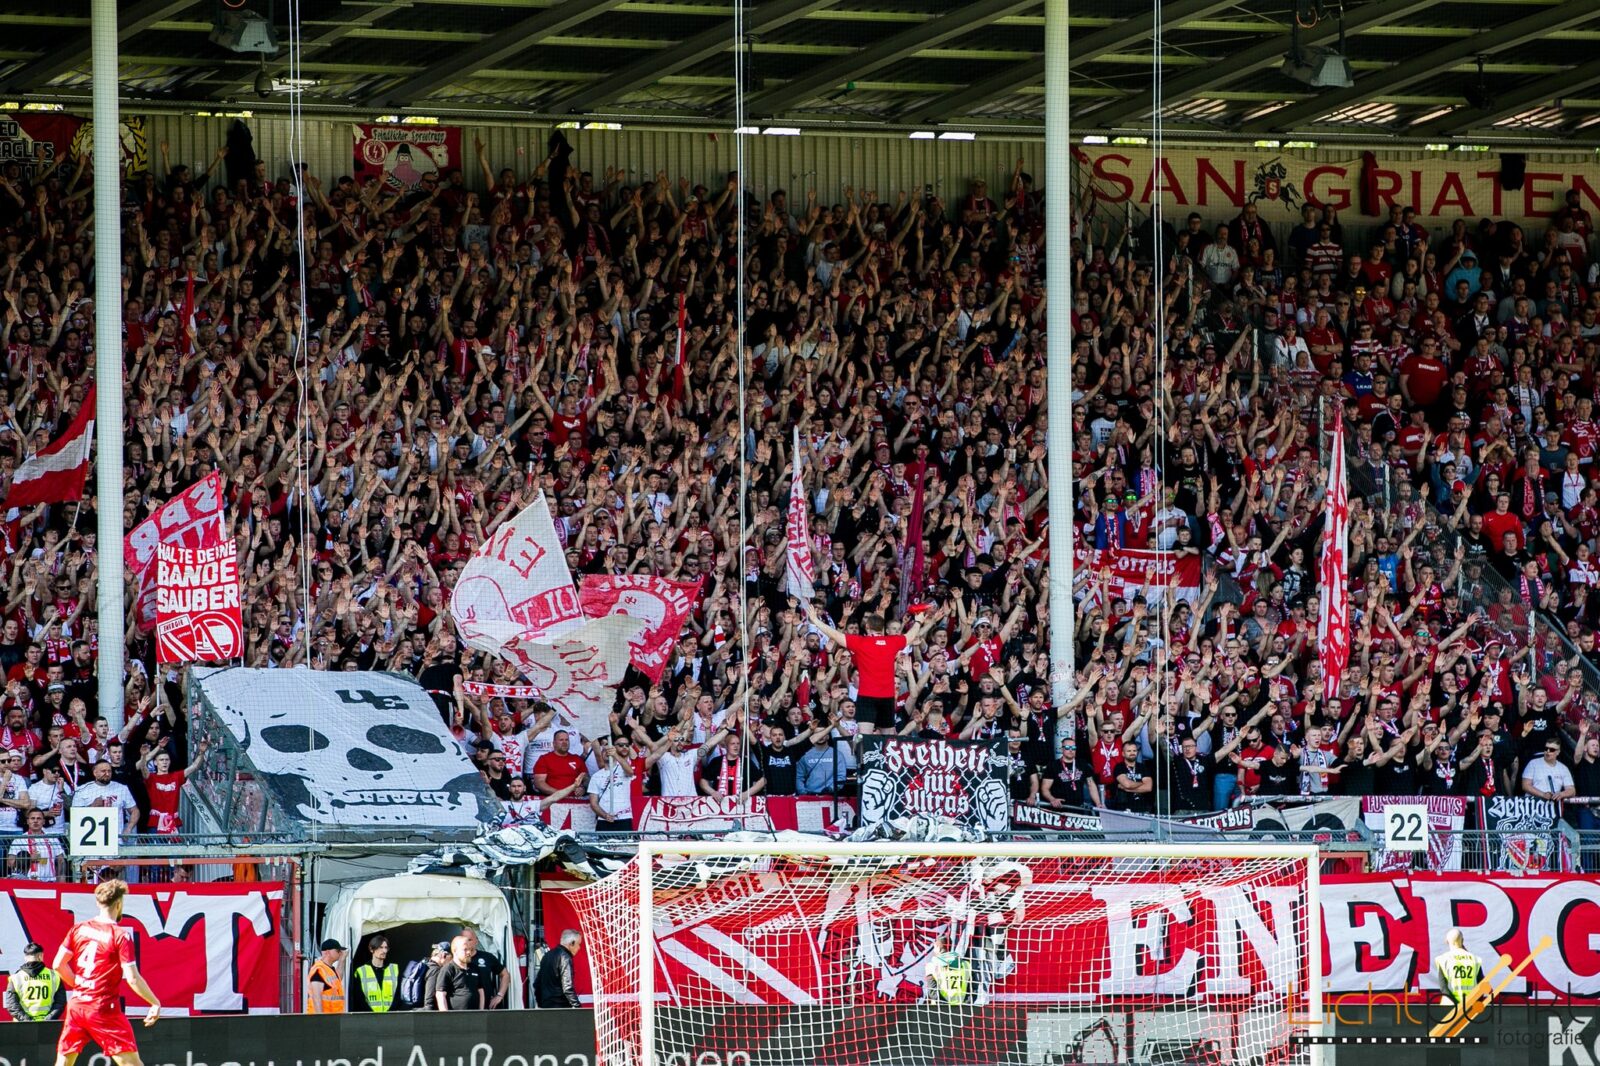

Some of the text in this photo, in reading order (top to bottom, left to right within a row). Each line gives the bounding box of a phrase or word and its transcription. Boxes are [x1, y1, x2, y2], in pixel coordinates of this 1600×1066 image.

[158, 538, 237, 564] HALTE DEINE
[157, 557, 237, 586] BANDE
[157, 583, 240, 613] SAUBER
[923, 770, 955, 793] für
[79, 816, 110, 847] 21
[1390, 813, 1423, 842] 22
[77, 938, 99, 978] 4
[1453, 965, 1473, 979] 262
[27, 985, 49, 1000] 270
